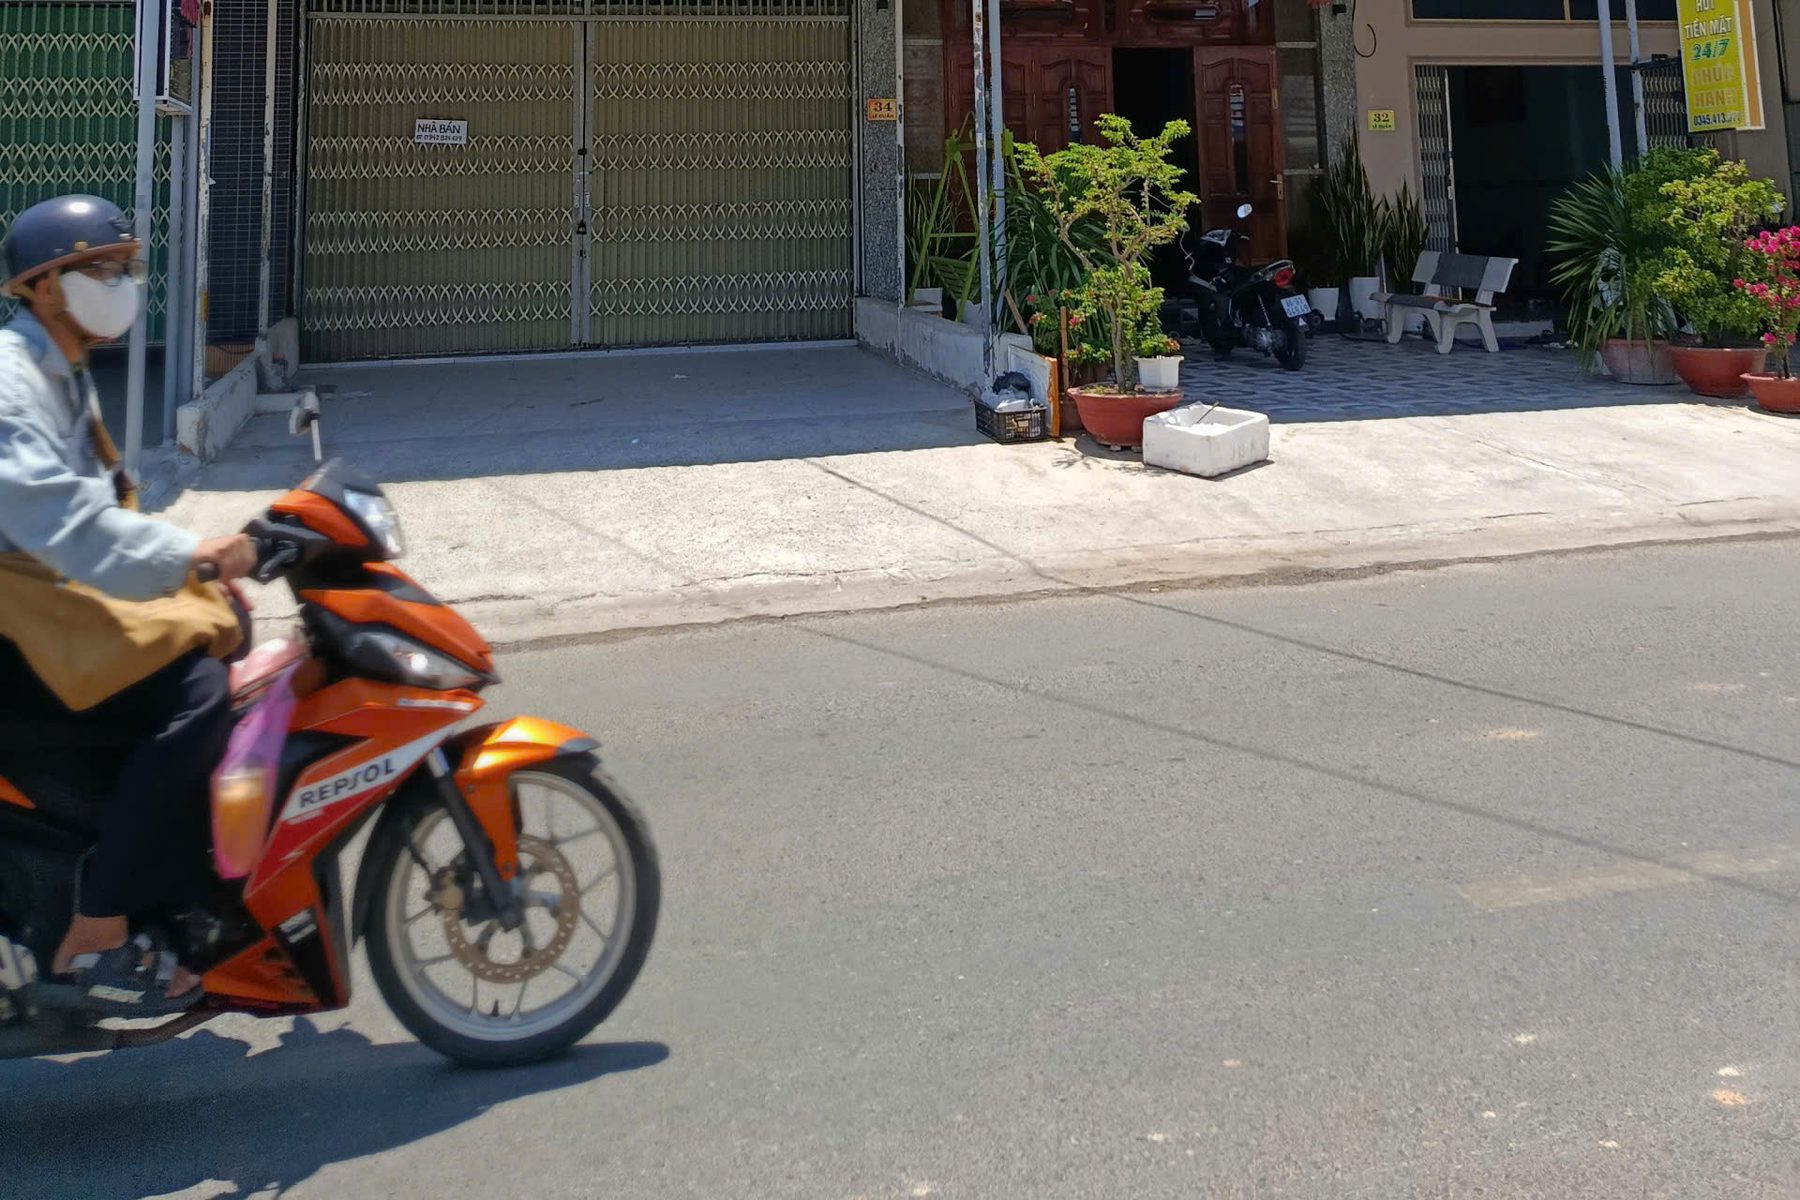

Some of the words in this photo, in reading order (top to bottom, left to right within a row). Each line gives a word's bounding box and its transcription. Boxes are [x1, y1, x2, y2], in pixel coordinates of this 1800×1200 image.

[1691, 39, 1730, 61] 24/7
[874, 101, 893, 112] 34
[1373, 112, 1390, 122] 32
[417, 121, 438, 133] NHÀ
[439, 121, 461, 134] BÁN
[299, 758, 396, 808] REPSOL
